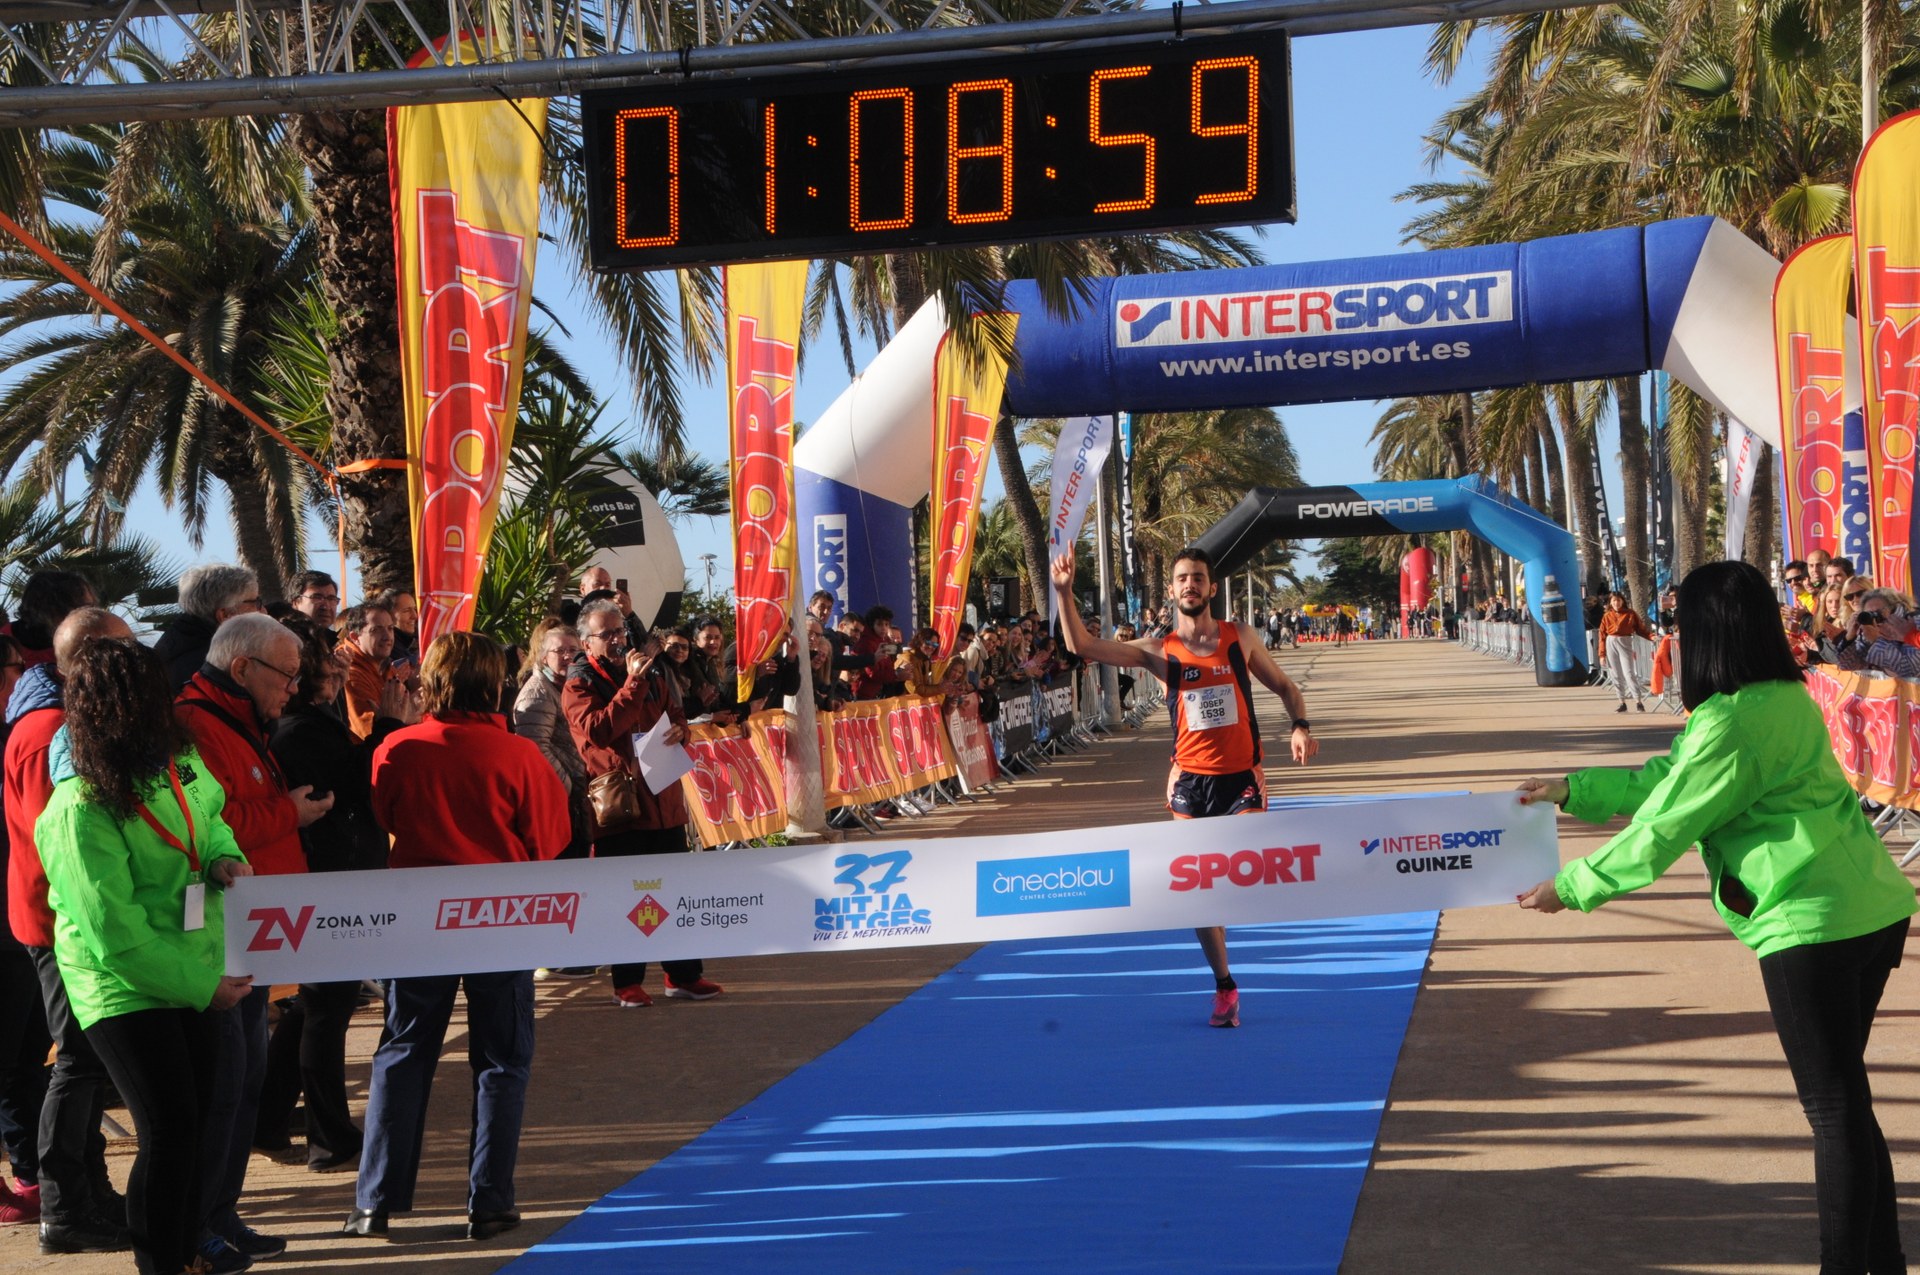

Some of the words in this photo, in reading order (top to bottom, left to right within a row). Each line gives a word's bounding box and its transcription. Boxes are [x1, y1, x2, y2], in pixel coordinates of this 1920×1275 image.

[615, 55, 1259, 248] 01:08:59
[1180, 276, 1498, 341] INTERSPORT
[1159, 340, 1472, 378] www.intersport.es
[1298, 496, 1434, 520] POWERADE
[1199, 698, 1224, 710] JOSEP
[1200, 707, 1226, 720] 1538
[1382, 829, 1503, 855] INTERSPORT
[1168, 843, 1321, 892] SPORT
[1396, 854, 1473, 874] QUINZE
[992, 865, 1114, 894] ànecblau
[676, 893, 763, 913] Ajuntament
[1019, 893, 1045, 901] CENTRE
[1047, 890, 1087, 899] COMERCIAL
[316, 915, 364, 930] ZONA
[370, 913, 397, 926] VIP
[676, 914, 695, 928] de
[701, 912, 748, 929] Sitges
[814, 909, 932, 932] SITGES
[331, 928, 383, 939] EVENTS
[835, 930, 849, 940] EL
